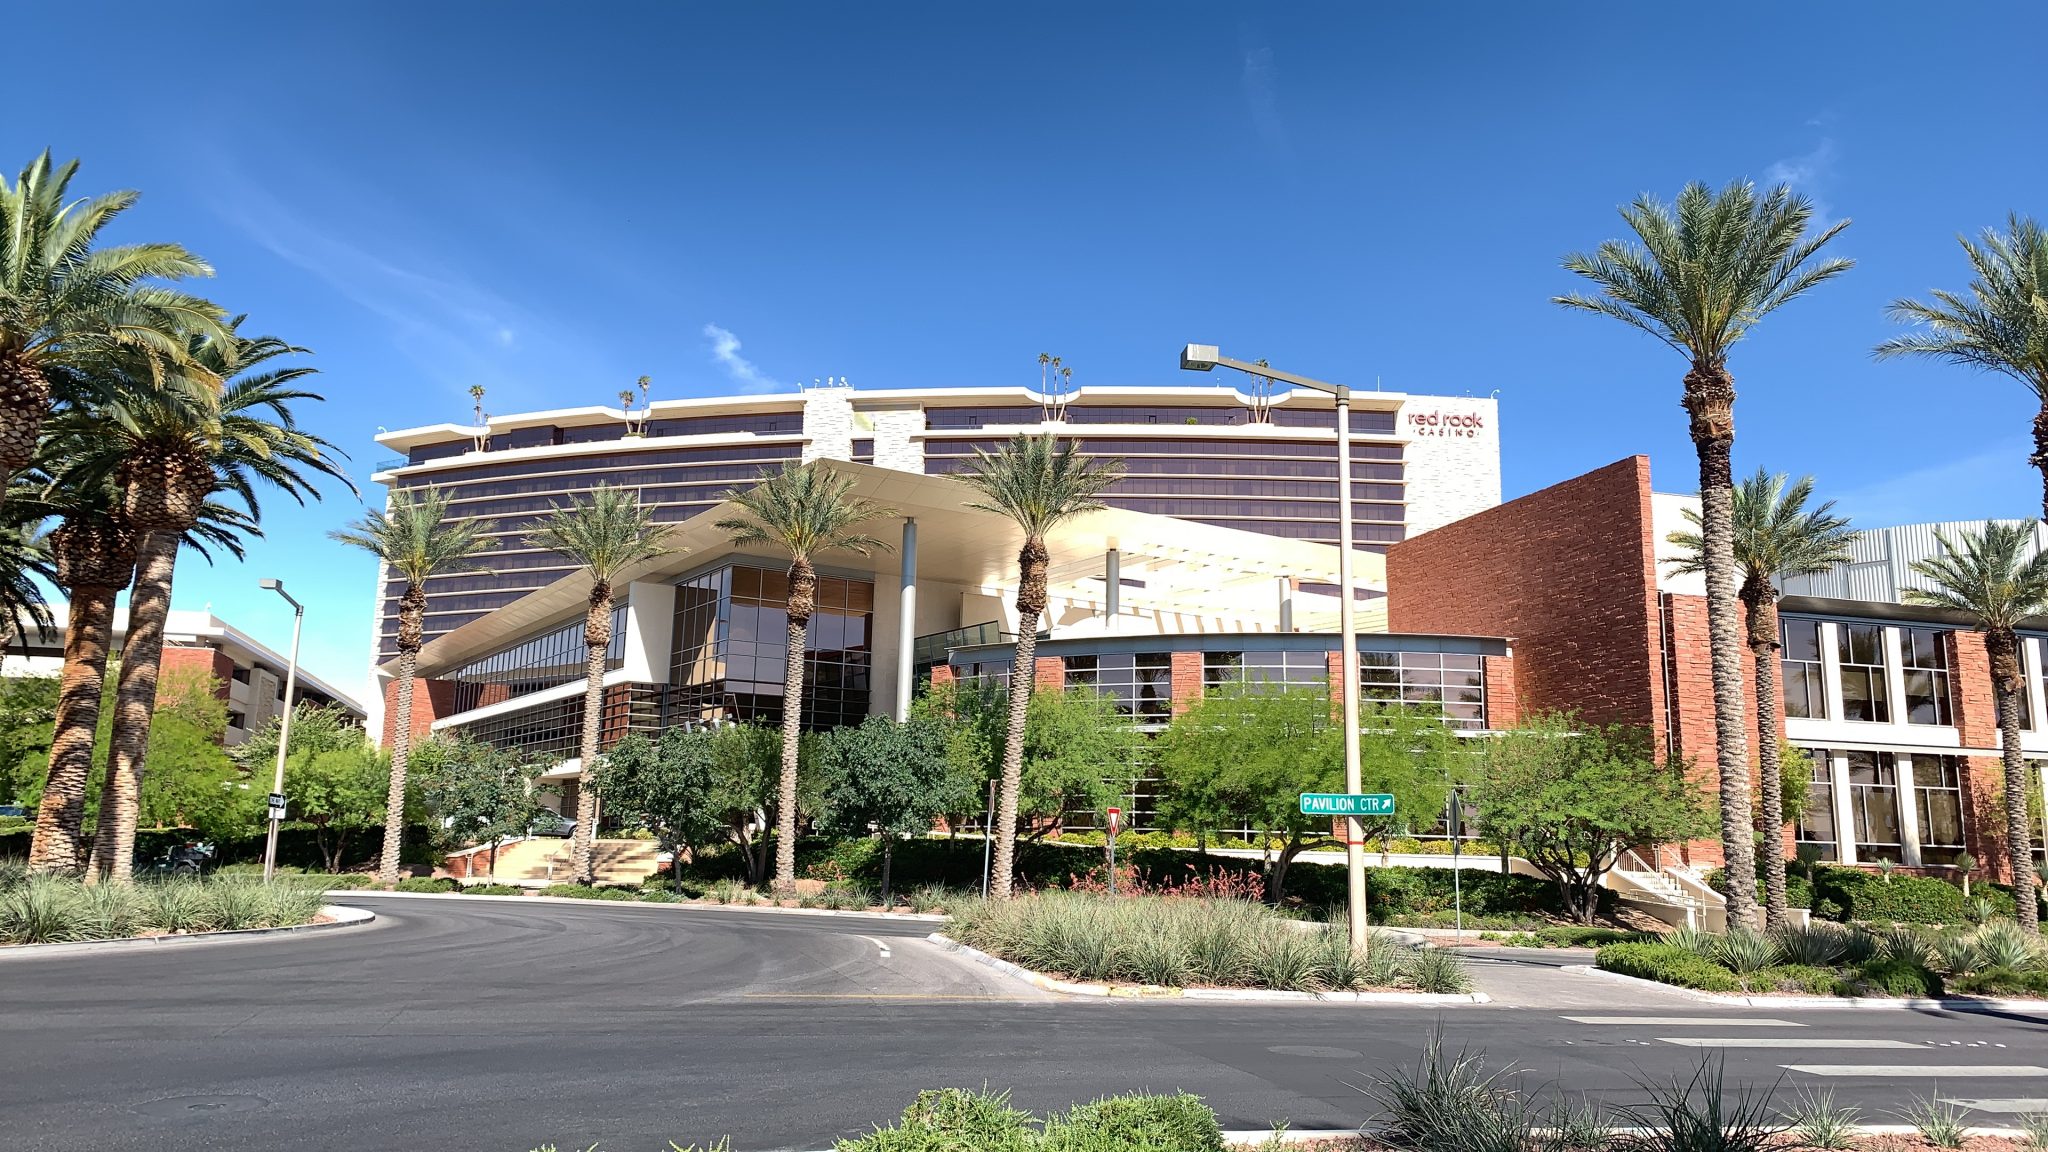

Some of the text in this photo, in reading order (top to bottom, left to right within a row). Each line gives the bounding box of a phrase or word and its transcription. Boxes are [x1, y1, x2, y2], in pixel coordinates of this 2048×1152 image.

[1408, 410, 1483, 428] red rock
[1418, 427, 1474, 438] CASINO
[1303, 797, 1380, 811] PAVILION CTR
